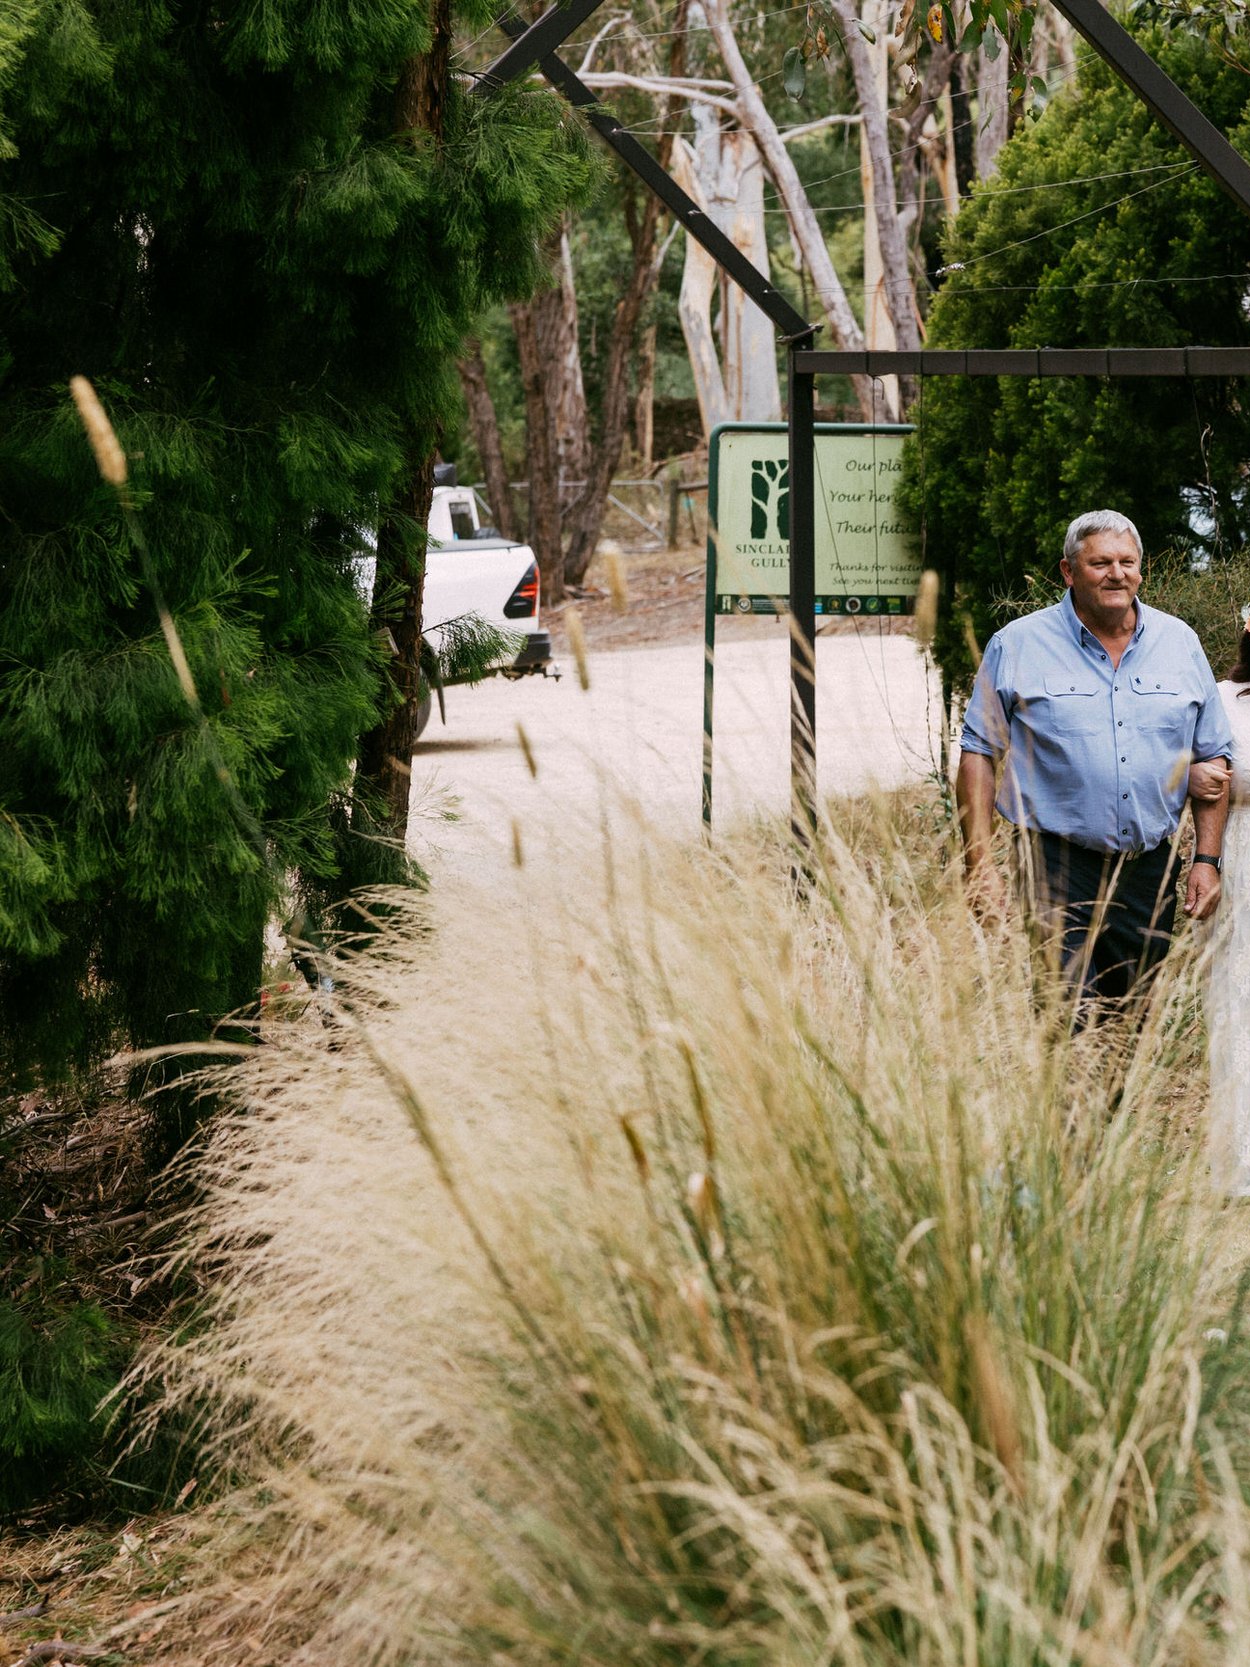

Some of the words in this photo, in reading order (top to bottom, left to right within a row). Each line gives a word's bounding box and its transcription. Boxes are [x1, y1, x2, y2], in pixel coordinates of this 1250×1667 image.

[845, 459, 876, 472] Our
[878, 458, 903, 476] pla
[829, 490, 866, 503] Your
[869, 489, 895, 503] her
[835, 520, 877, 534] Their
[878, 519, 912, 537] futu
[736, 543, 791, 555] SINCLAI
[751, 557, 791, 568] GULL
[829, 562, 869, 572] Thanks
[871, 563, 887, 573] for
[889, 562, 921, 572] visitin
[832, 577, 850, 586] See
[851, 579, 873, 588] you
[875, 577, 900, 586] next
[901, 577, 921, 586] tim
